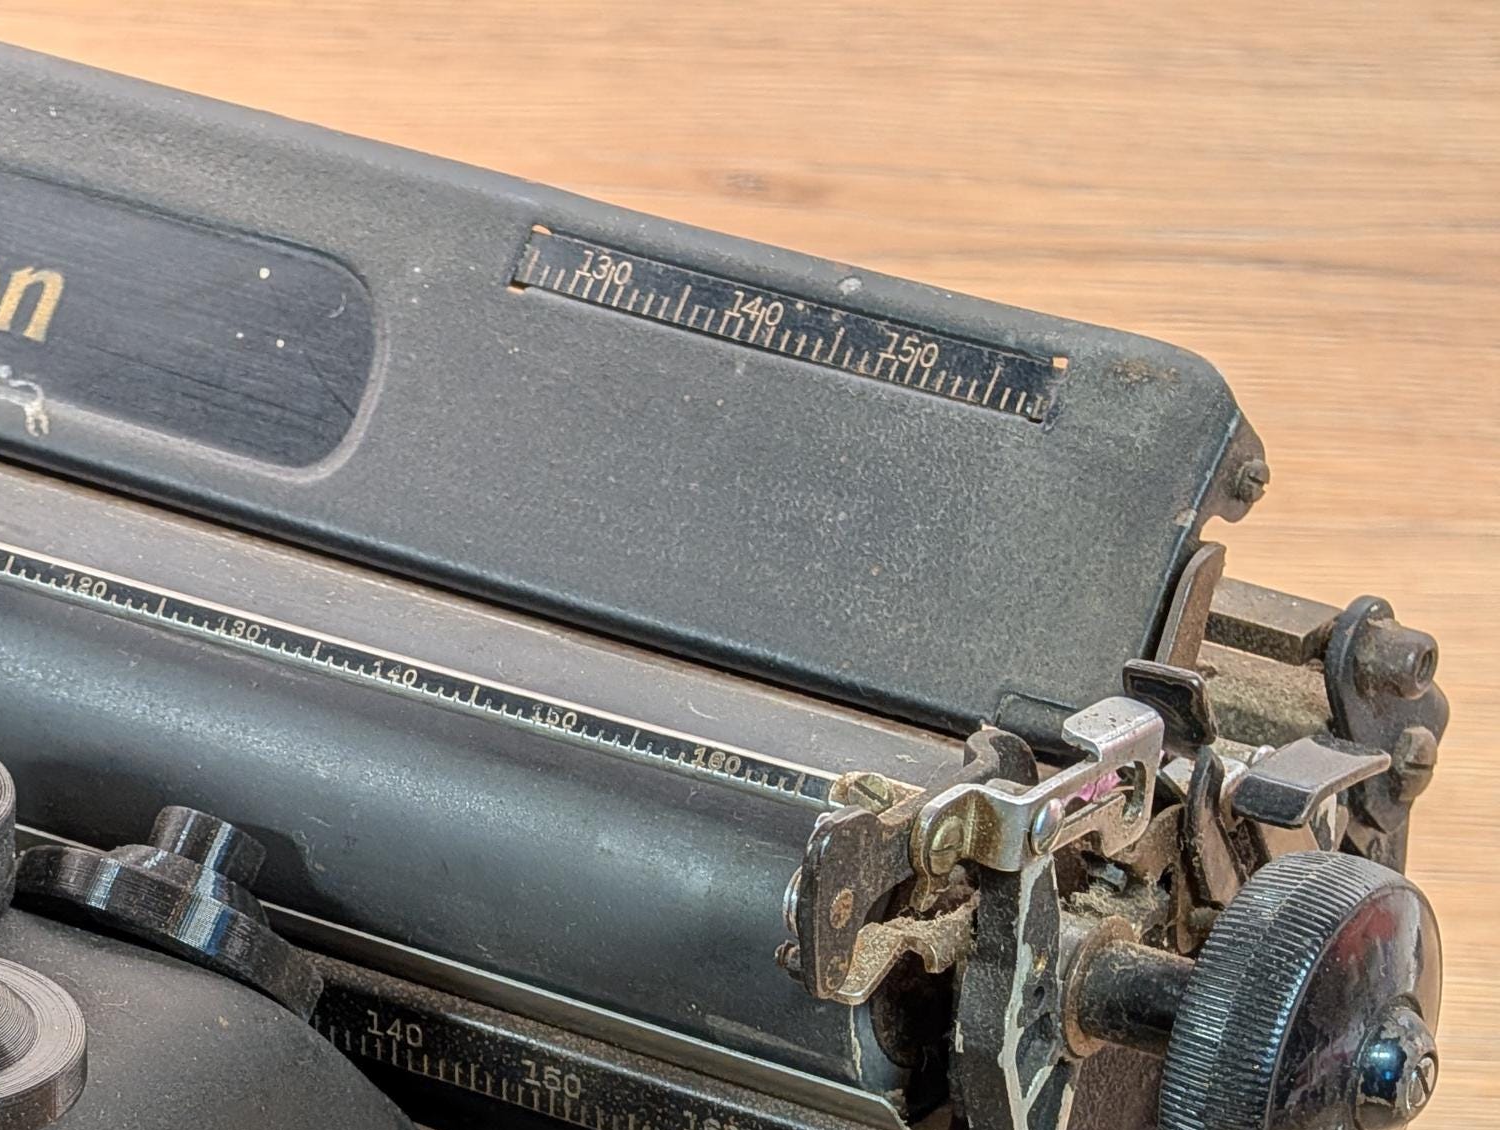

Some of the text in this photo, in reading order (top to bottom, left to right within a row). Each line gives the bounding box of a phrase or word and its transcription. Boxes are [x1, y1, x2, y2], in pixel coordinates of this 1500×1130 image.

[576, 250, 938, 368] 130 140 150
[63, 572, 108, 599] 120
[217, 616, 262, 642] 130
[370, 660, 417, 687] 140
[531, 703, 578, 730] 150
[692, 748, 741, 774] 160
[367, 1010, 423, 1048] 140
[522, 1059, 581, 1098] 150
